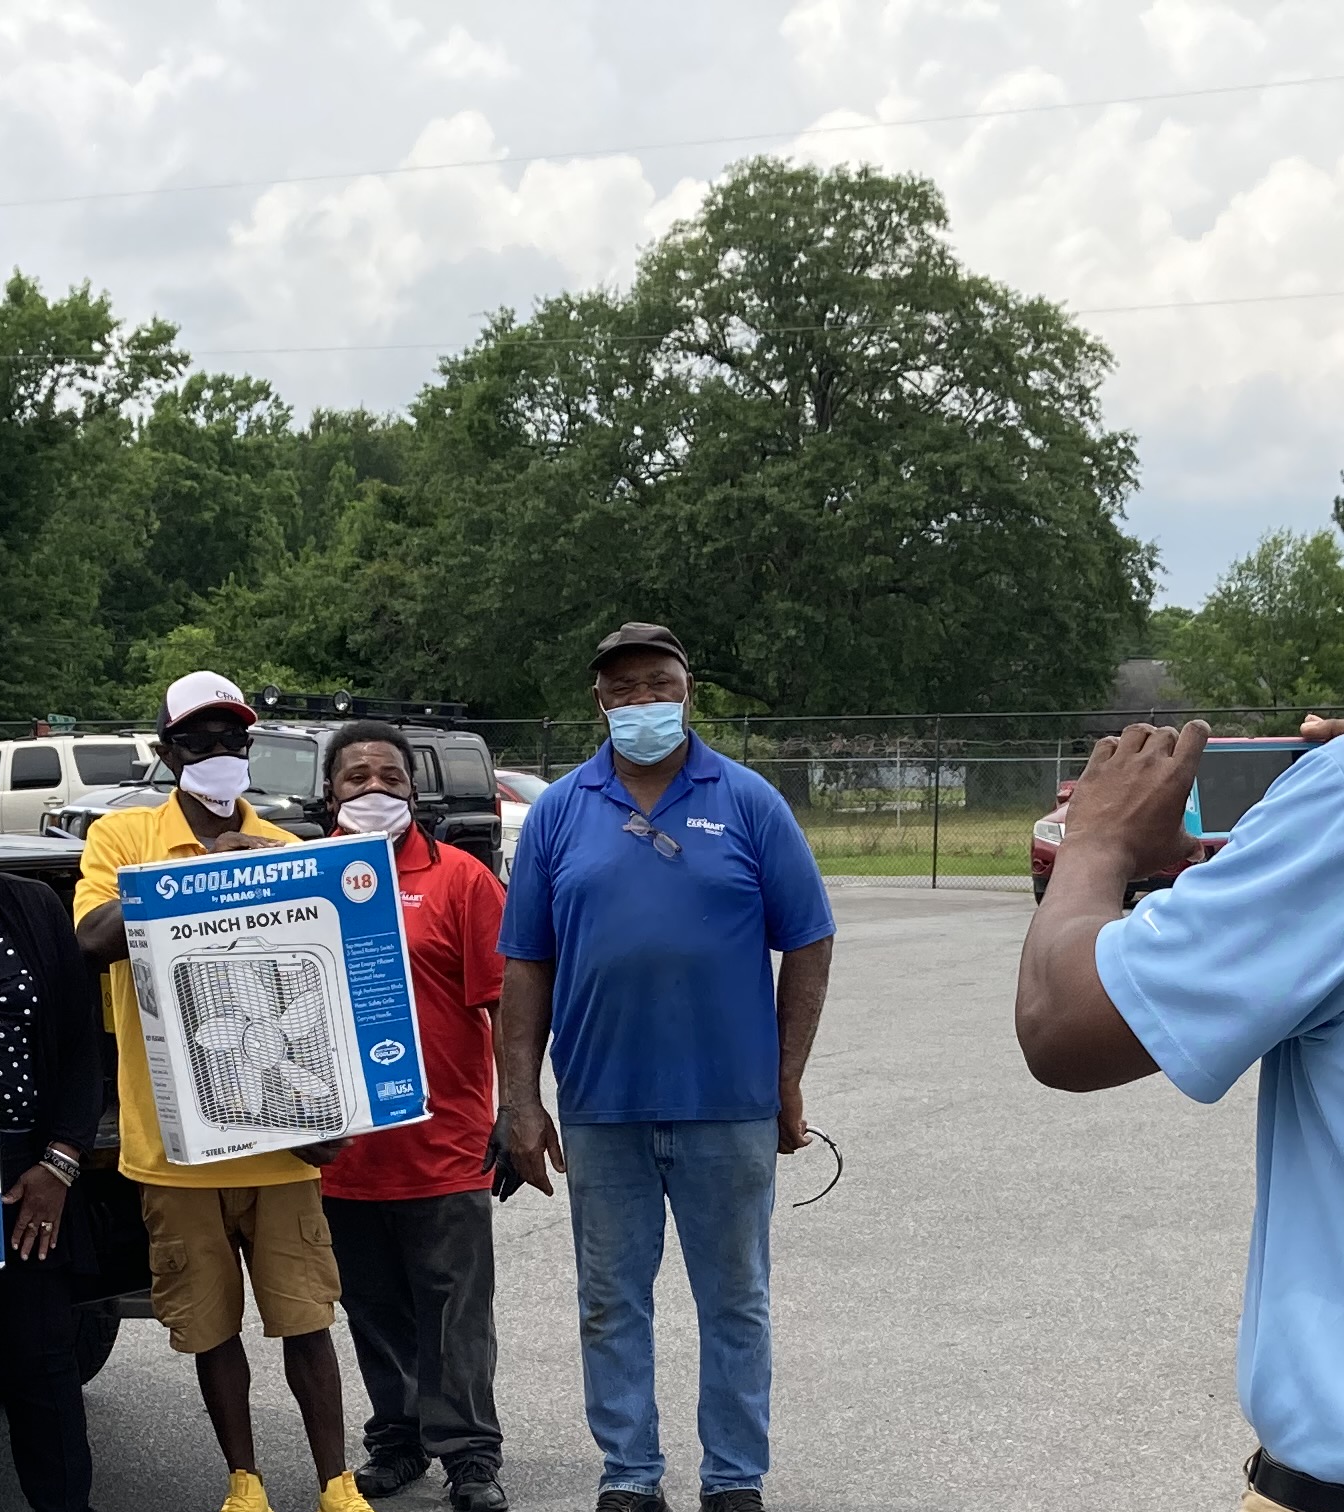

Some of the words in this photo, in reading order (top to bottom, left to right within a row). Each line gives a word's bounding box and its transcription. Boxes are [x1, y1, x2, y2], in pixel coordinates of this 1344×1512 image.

[181, 858, 318, 895] COOLMASTER
[345, 873, 373, 890] $18
[170, 917, 241, 940] 20-INCH
[246, 910, 283, 929] BOX
[286, 906, 318, 923] FAN
[396, 1083, 414, 1094] USA
